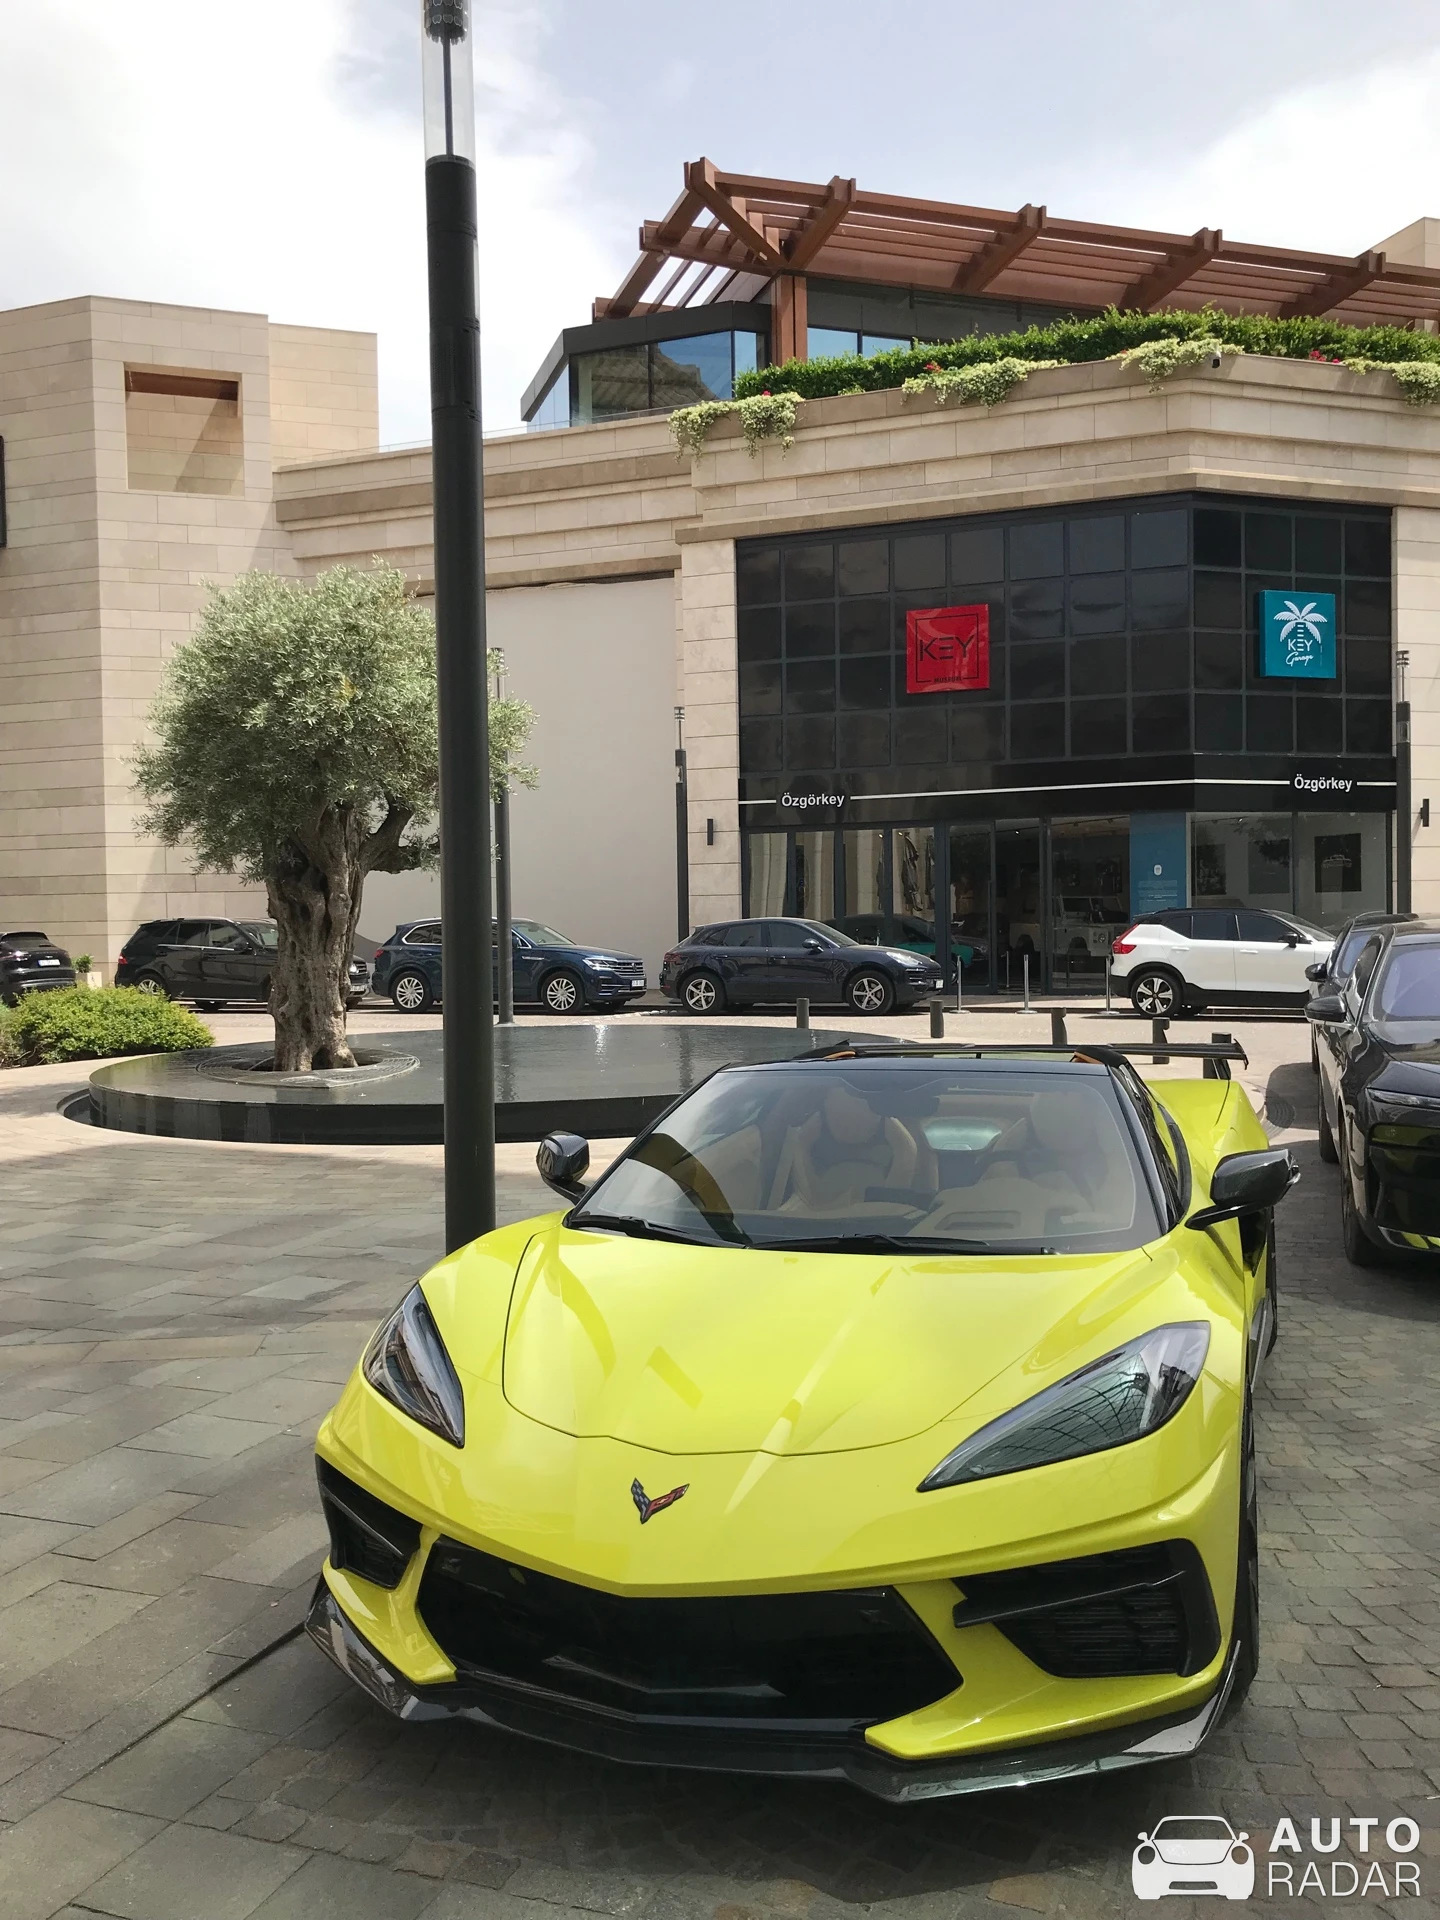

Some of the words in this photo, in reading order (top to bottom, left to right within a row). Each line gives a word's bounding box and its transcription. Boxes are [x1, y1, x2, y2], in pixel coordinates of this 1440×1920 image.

[919, 634, 976, 661] KEY
[1287, 638, 1313, 652] KEY
[1285, 651, 1314, 667] Garage
[1294, 773, 1353, 793] Özgörkey
[781, 792, 845, 809] Özgörkey
